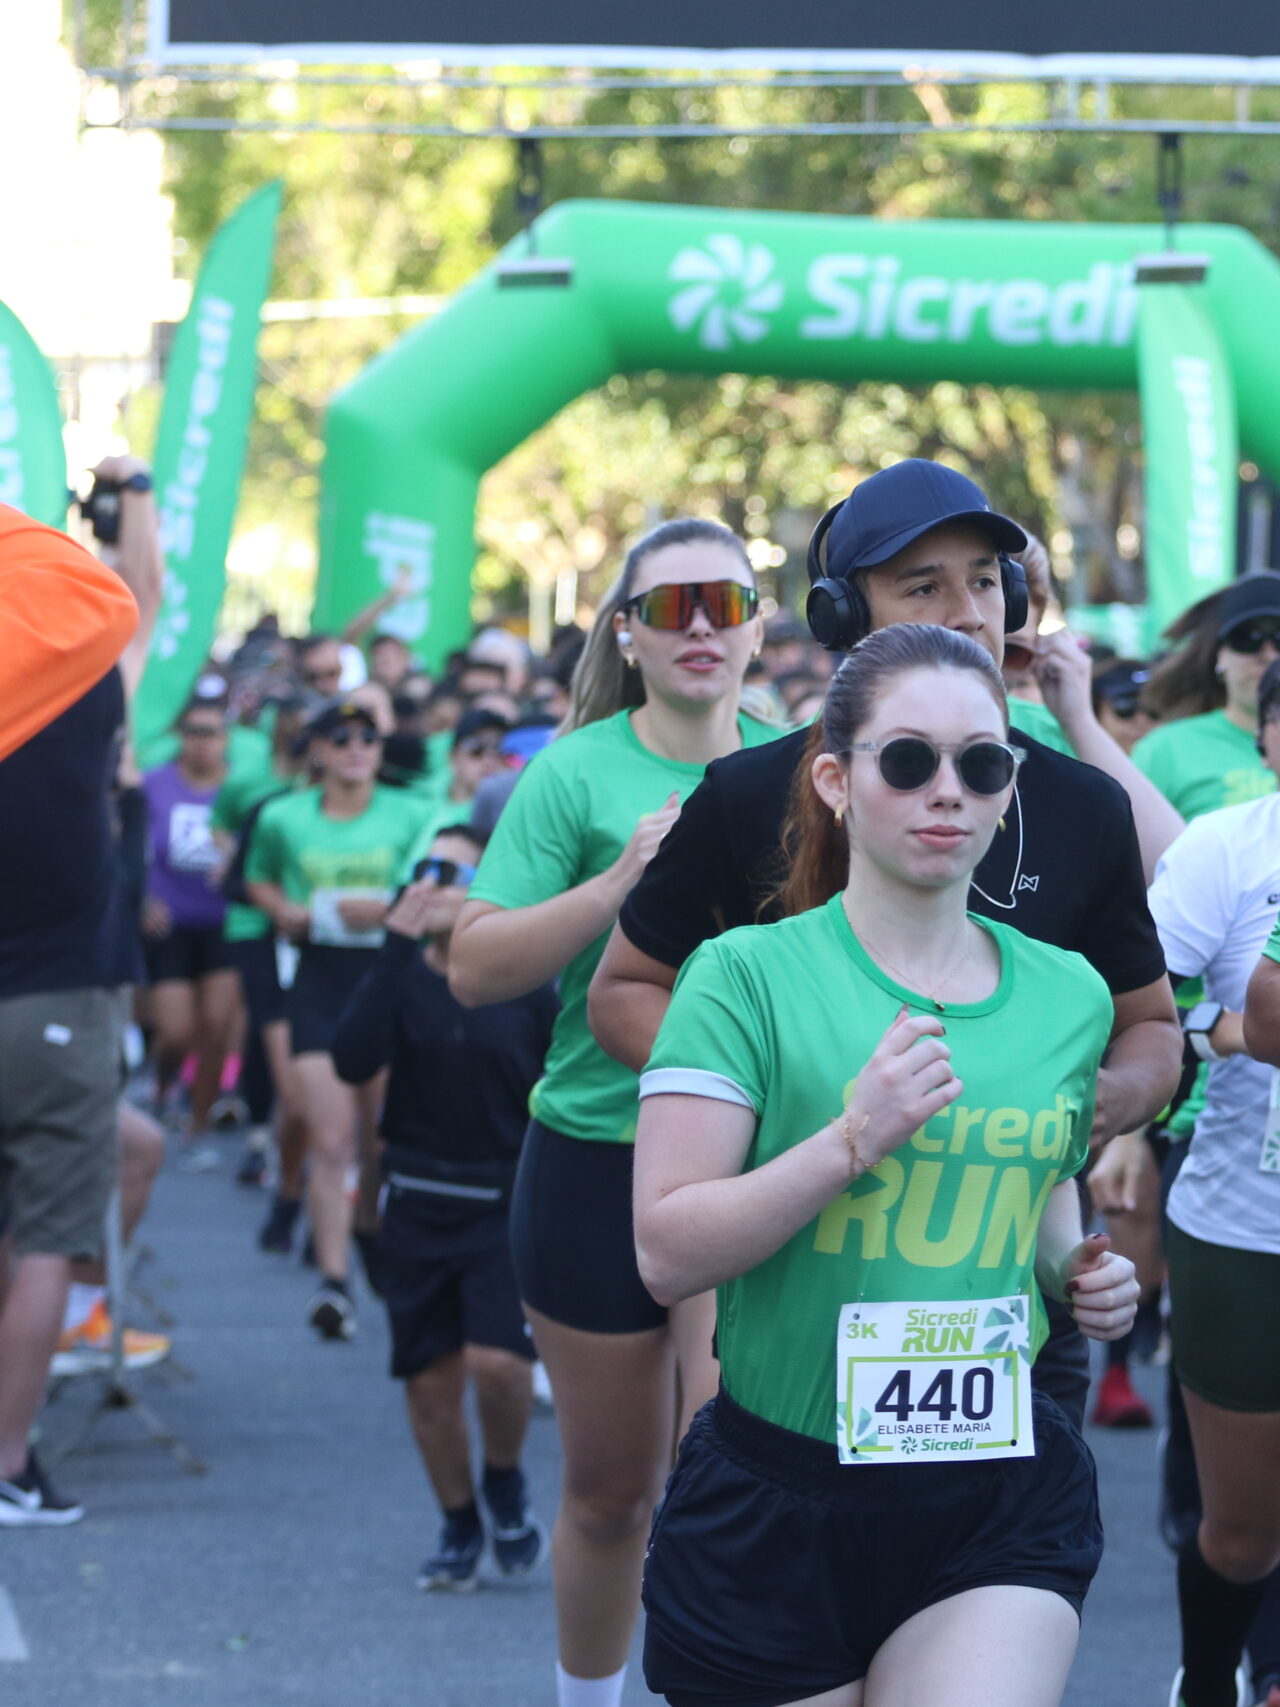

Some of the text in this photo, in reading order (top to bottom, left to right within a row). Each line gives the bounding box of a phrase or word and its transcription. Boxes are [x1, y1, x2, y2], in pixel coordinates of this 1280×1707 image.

[798, 252, 1140, 347] Sicredi
[906, 1307, 979, 1326] Sicredi
[846, 1322, 879, 1340] 3K
[901, 1326, 975, 1353] RUN
[874, 1366, 994, 1422] 440
[878, 1422, 991, 1435] ELISABETE MARIA
[921, 1437, 974, 1451] Sicredi
